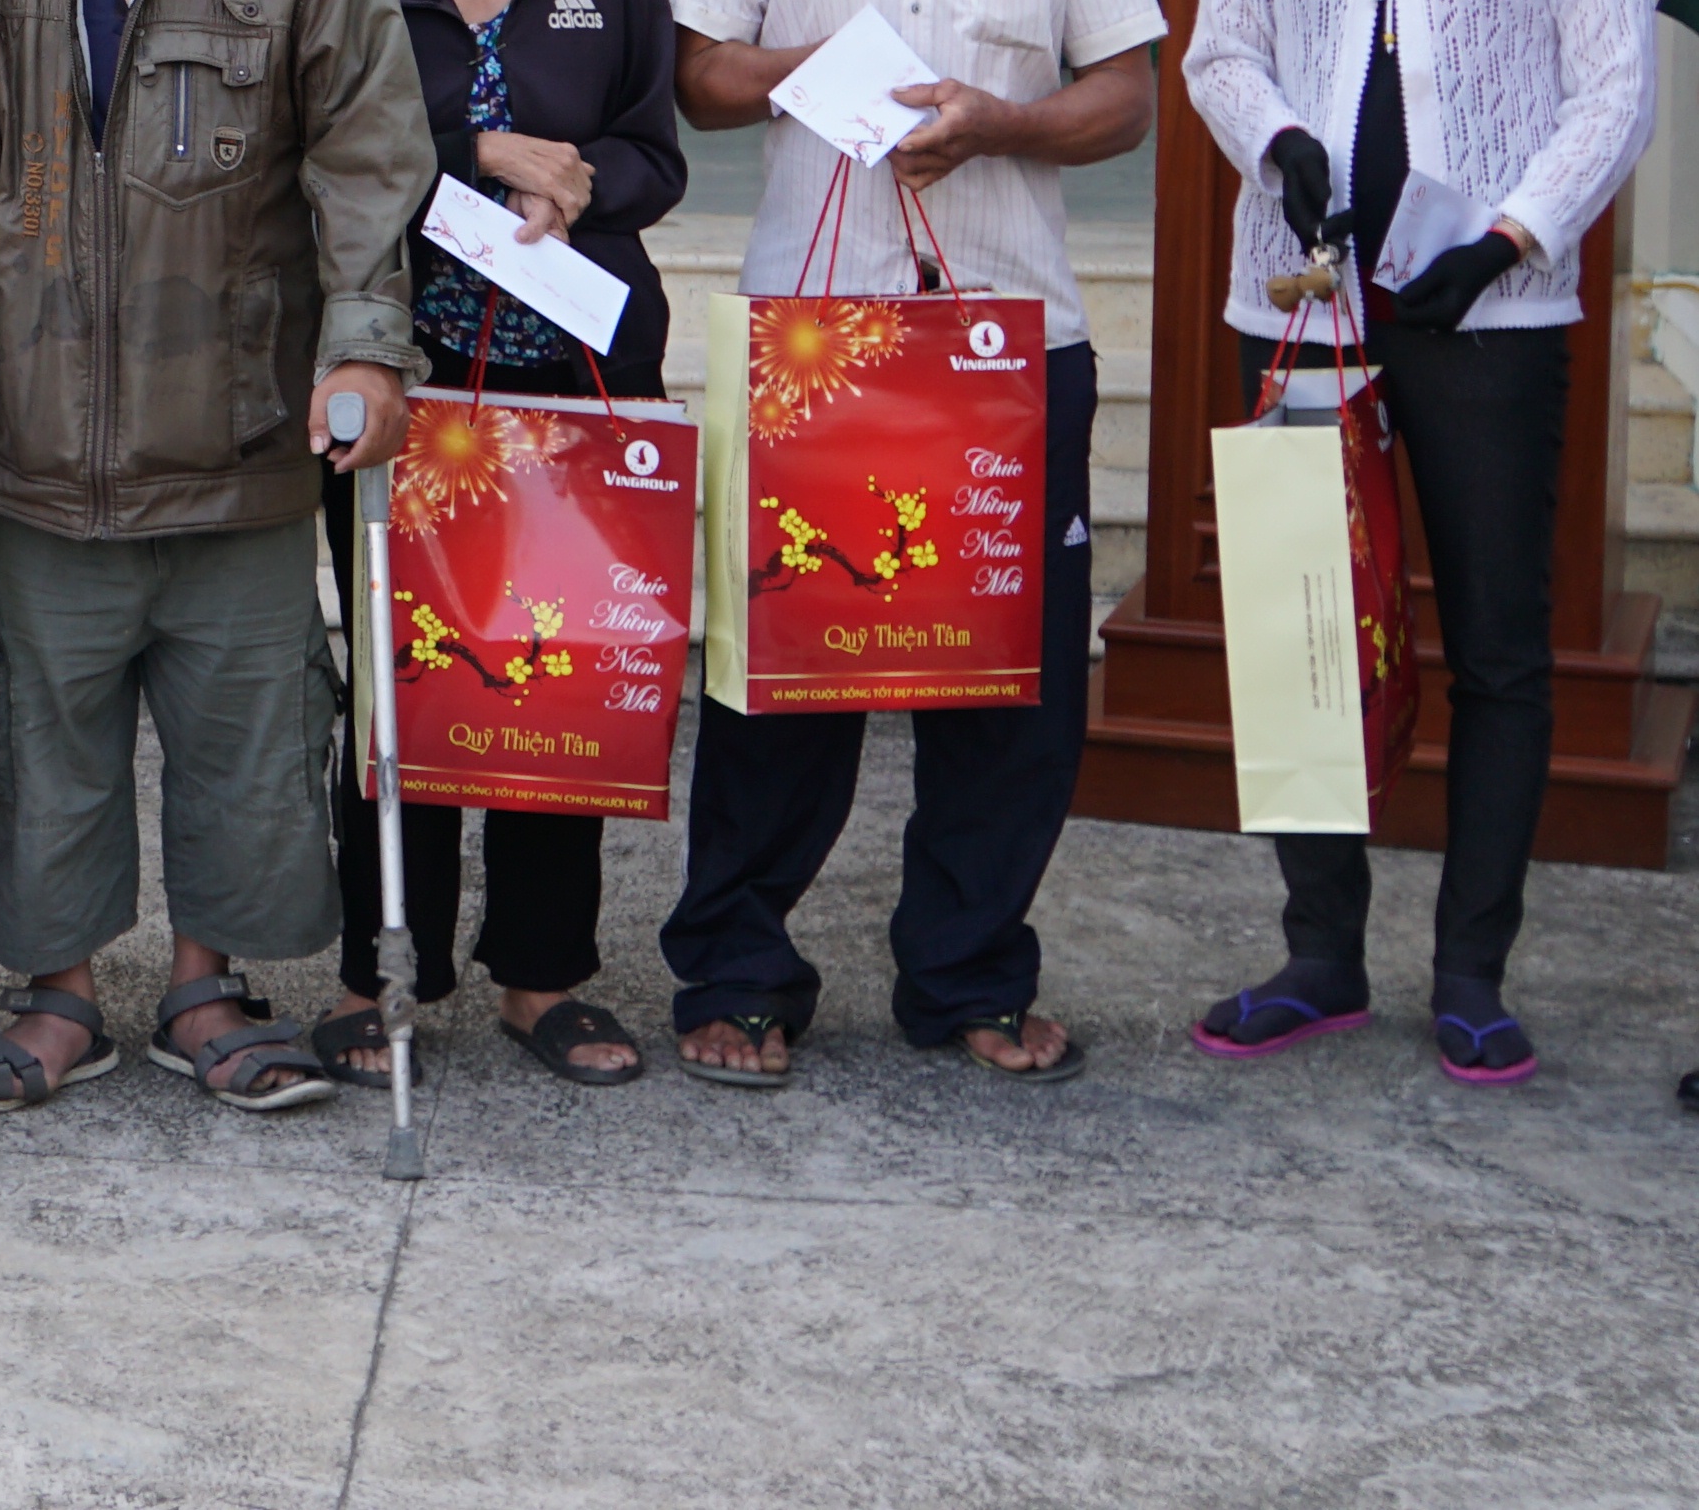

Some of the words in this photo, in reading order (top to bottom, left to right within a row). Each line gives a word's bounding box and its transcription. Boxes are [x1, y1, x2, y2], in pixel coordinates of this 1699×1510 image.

[548, 9, 604, 30] adidas
[949, 355, 1026, 371] VINGROUP
[964, 447, 1023, 478] Chúc
[603, 470, 679, 491] VINGROUP
[951, 485, 1022, 526] Mừng
[960, 529, 1021, 559] Năm
[608, 563, 668, 596] Chúc
[971, 565, 1023, 595] Mới
[589, 600, 666, 642] Mừng
[825, 625, 868, 655] Quỹ
[873, 624, 928, 652] Thiện
[933, 622, 971, 647] Tâm
[595, 646, 663, 676] Năm
[604, 681, 661, 713] Mới
[448, 723, 494, 755] Quỹ
[501, 727, 555, 757] Thiện
[561, 732, 600, 757] Tâm
